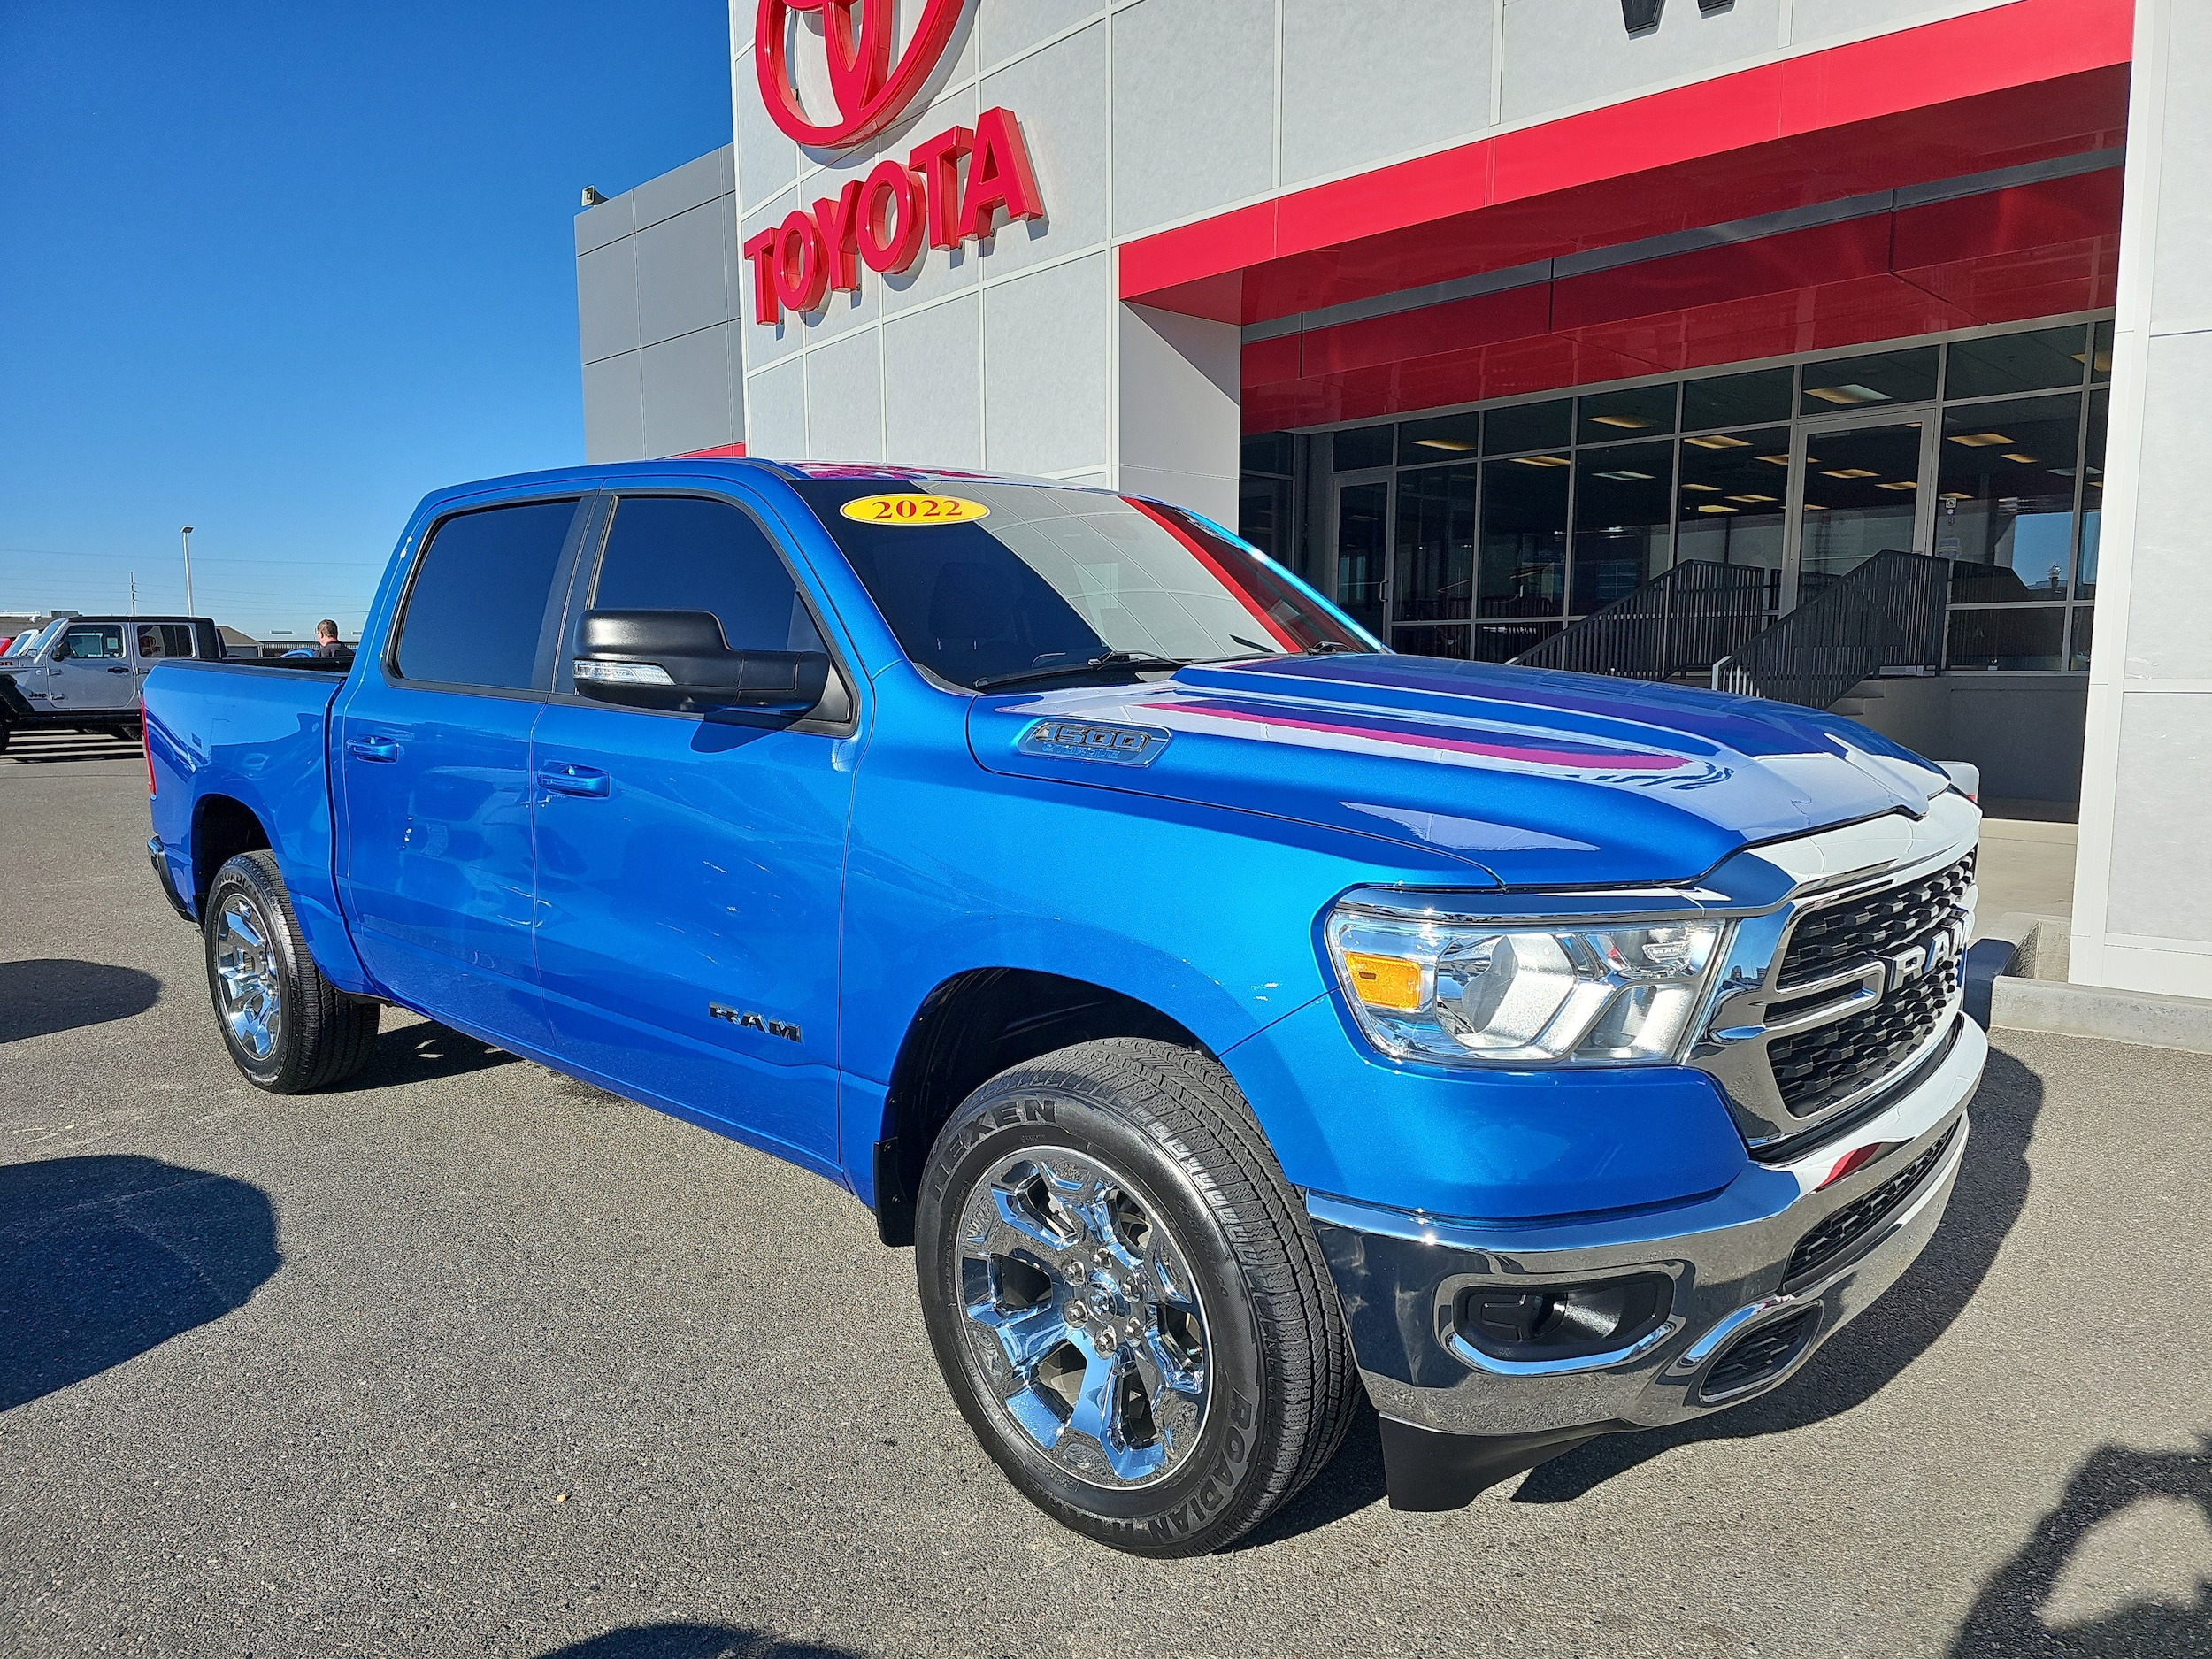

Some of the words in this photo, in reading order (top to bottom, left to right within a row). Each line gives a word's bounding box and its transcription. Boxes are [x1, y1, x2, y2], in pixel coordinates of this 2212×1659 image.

[744, 106, 1043, 326] TOYOTA
[872, 500, 963, 519] 2022
[1034, 723, 1151, 752] 1500
[1887, 918, 1964, 992] RAM
[709, 1001, 803, 1044] RAM
[930, 1099, 1056, 1203] NEXEN
[1148, 1386, 1254, 1541] ROADIAN
